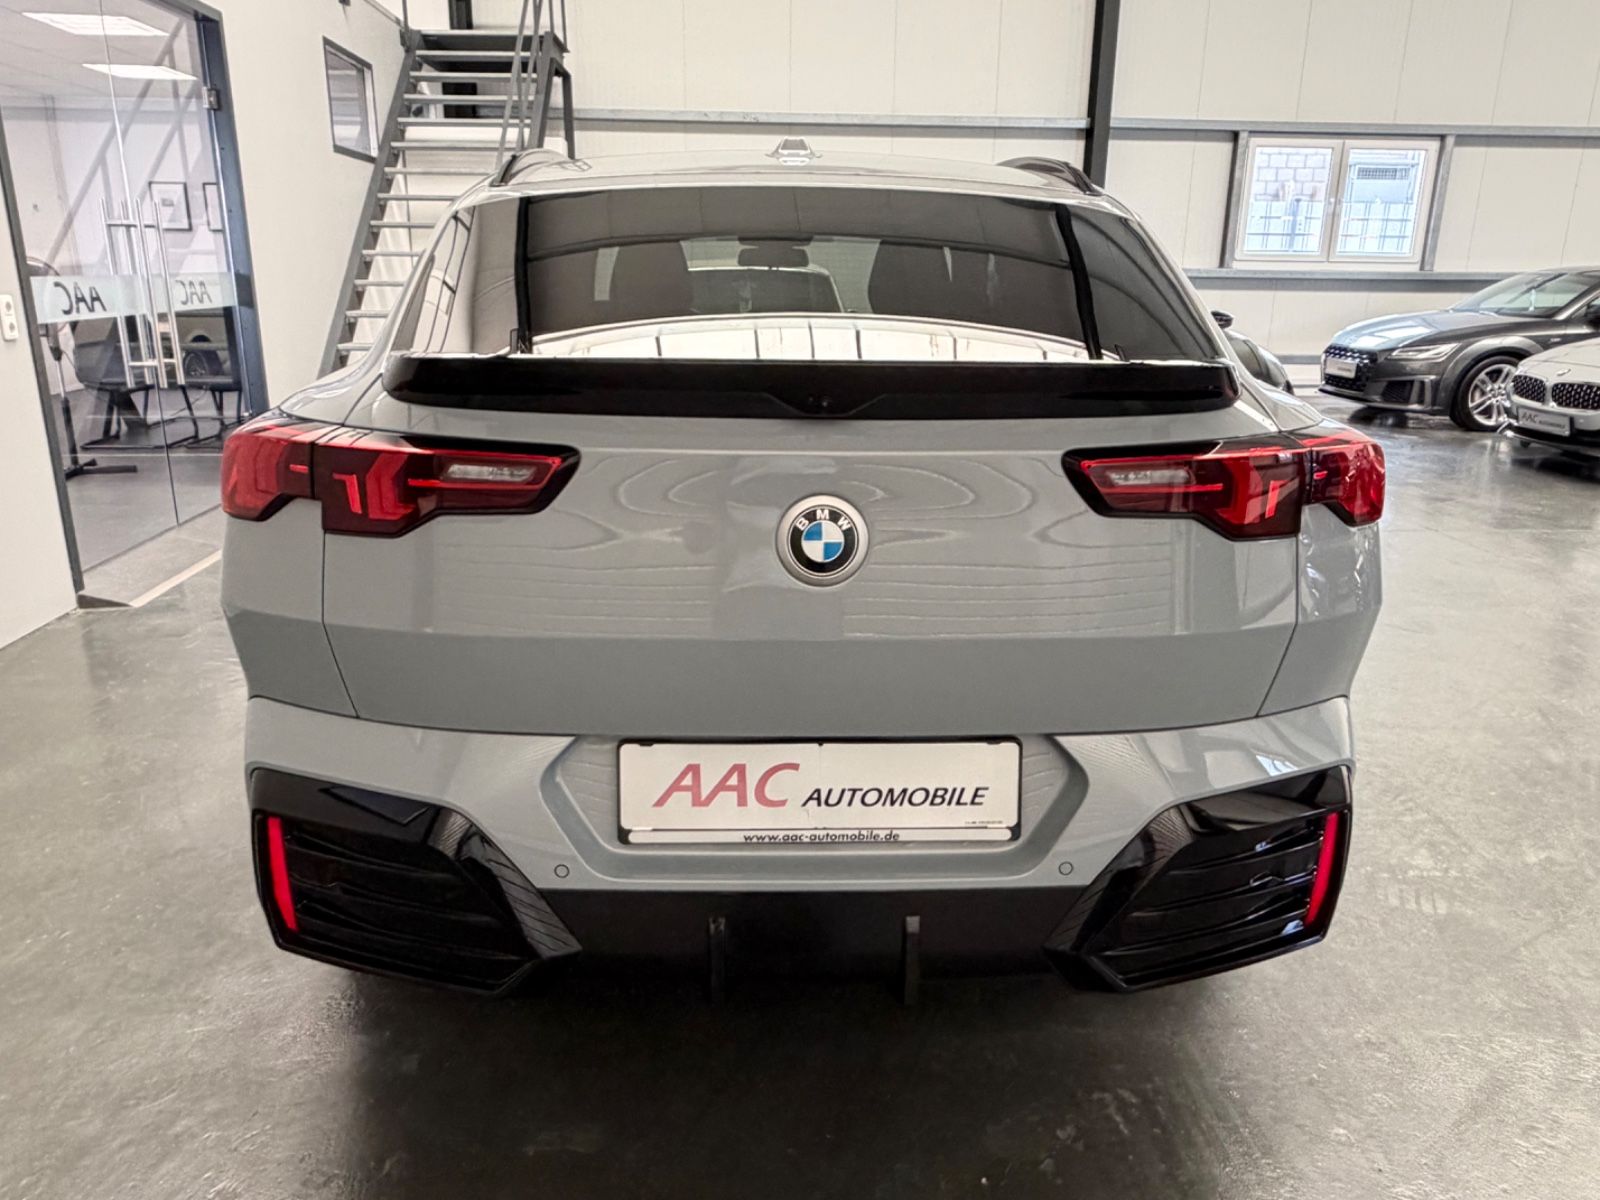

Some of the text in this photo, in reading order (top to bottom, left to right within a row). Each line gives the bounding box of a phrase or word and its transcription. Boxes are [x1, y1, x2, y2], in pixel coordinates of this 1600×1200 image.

[796, 509, 851, 531] BMW
[652, 763, 989, 808] AAC AUTOMOBILE
[743, 830, 900, 842] www.aac-automobile.de
